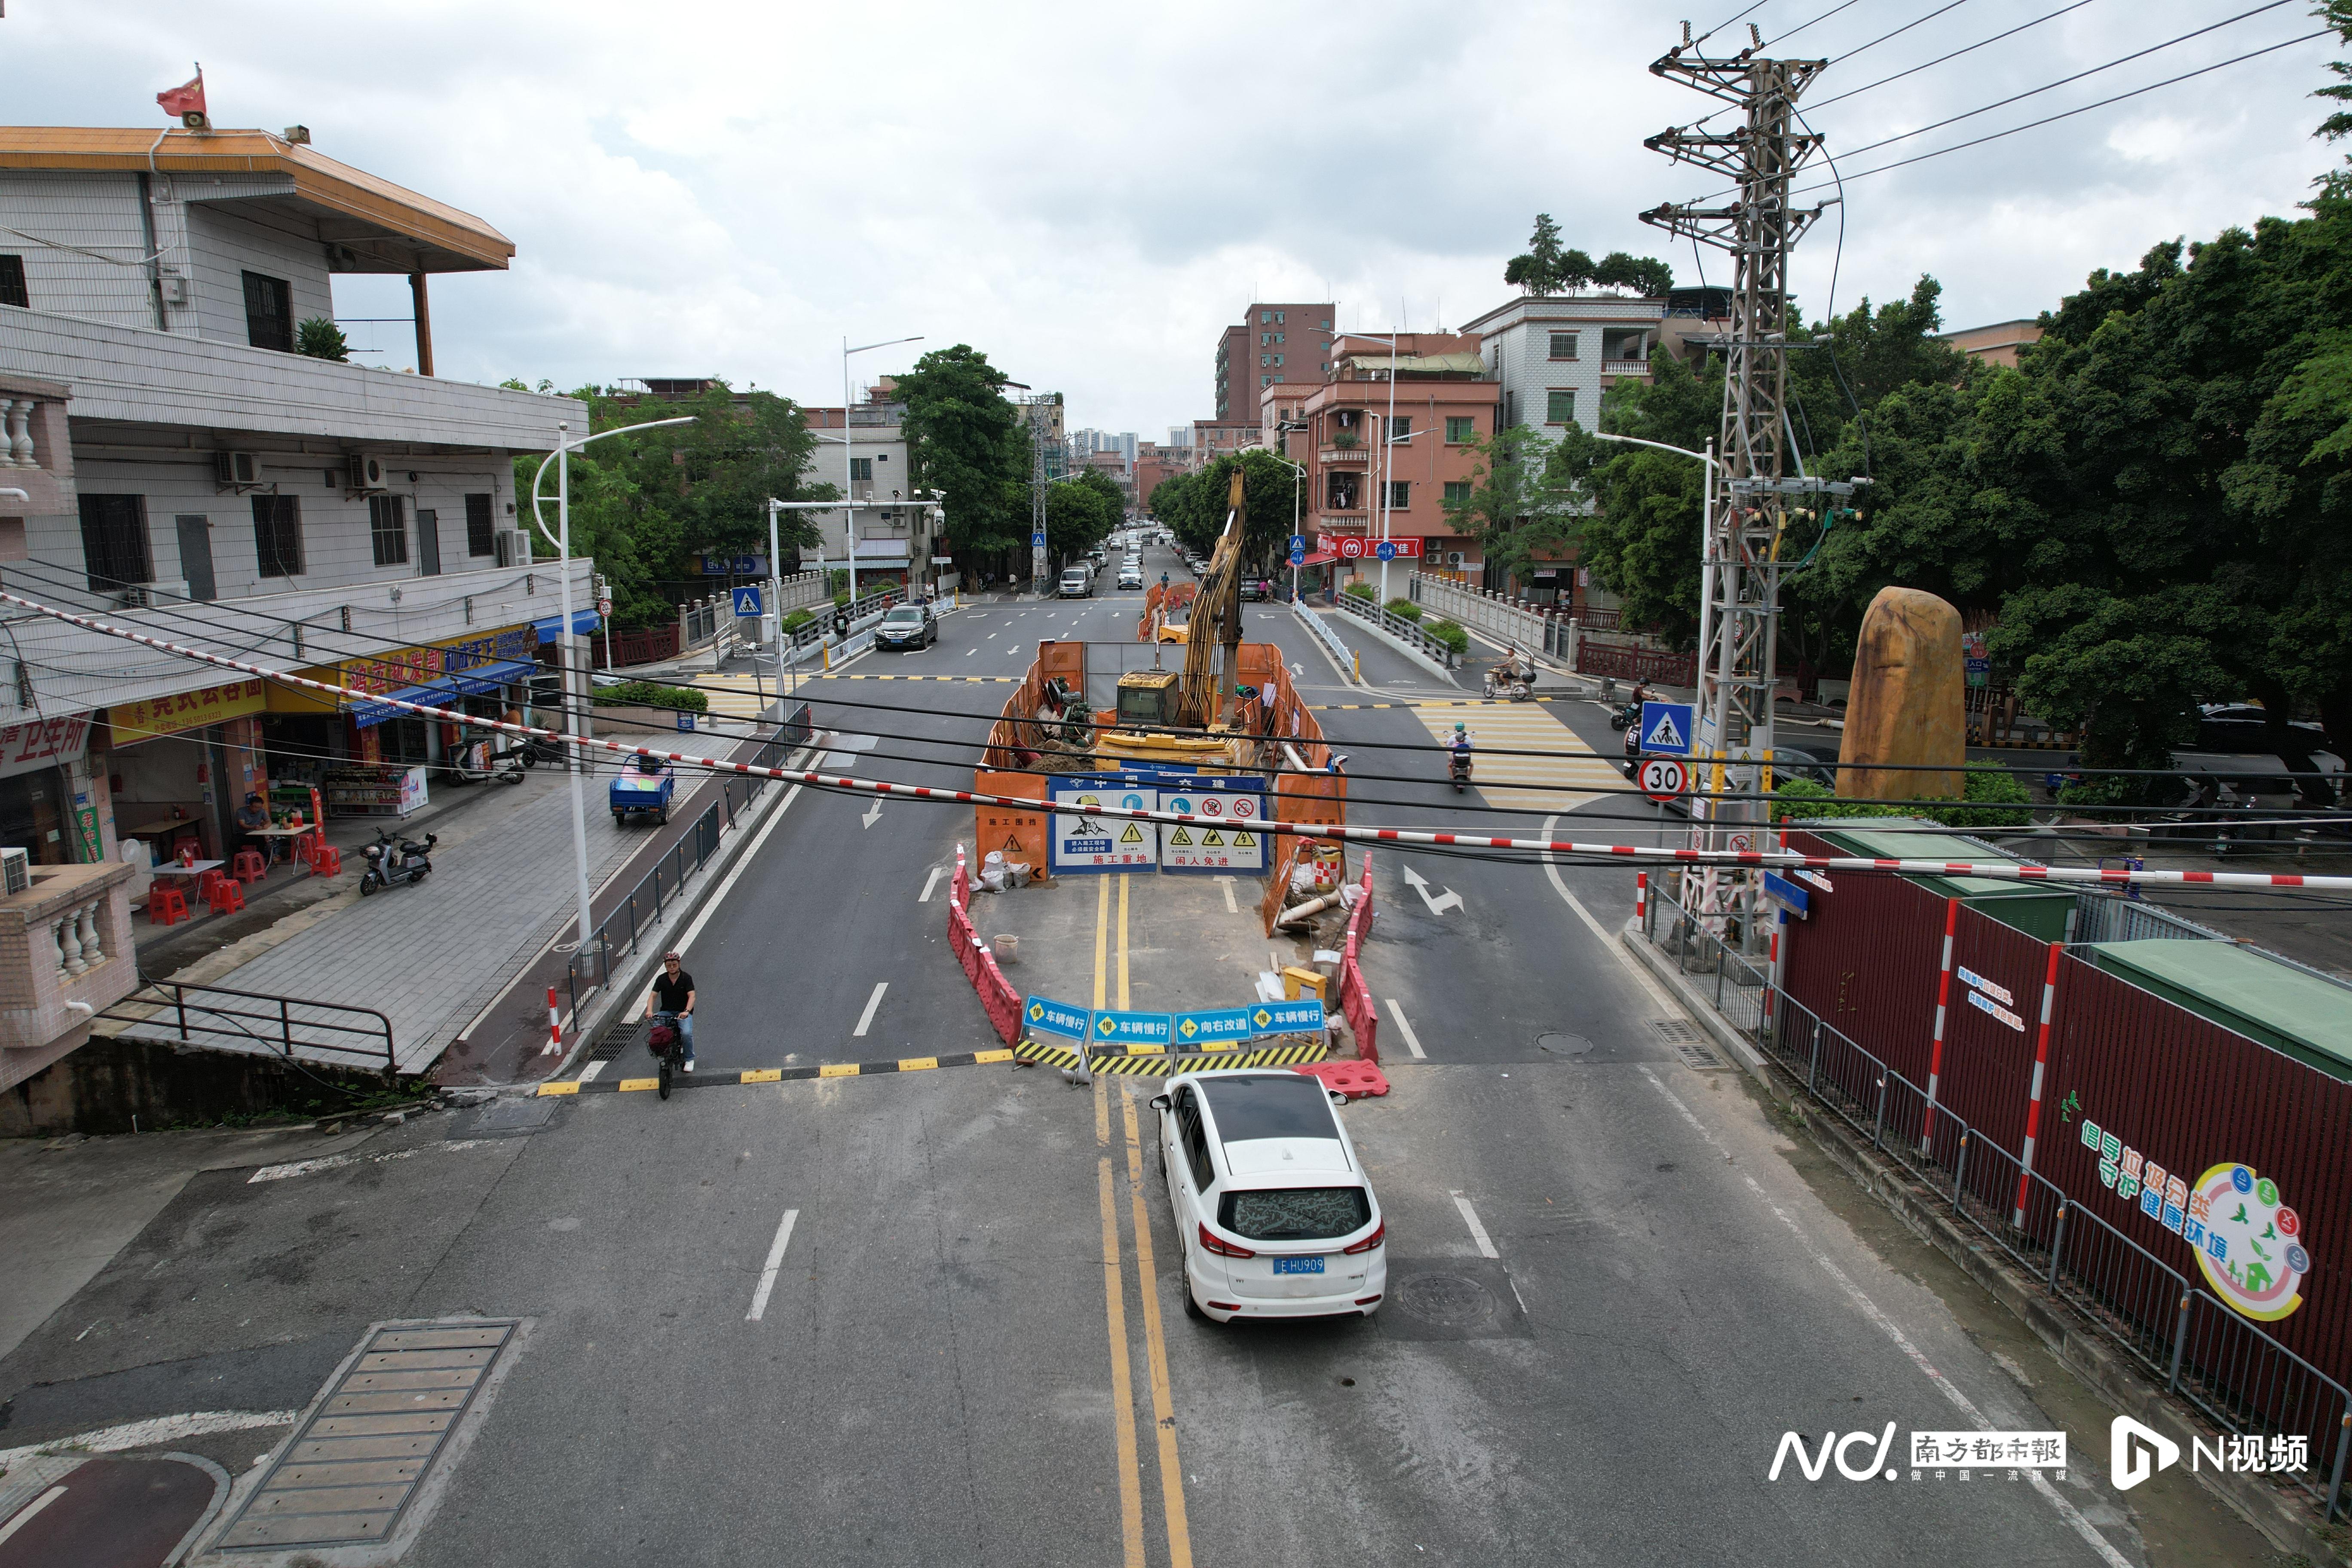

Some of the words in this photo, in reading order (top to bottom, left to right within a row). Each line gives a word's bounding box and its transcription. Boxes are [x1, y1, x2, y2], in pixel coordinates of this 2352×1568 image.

[14, 711, 89, 763] 卫生所
[1628, 732, 1638, 744] 91
[1650, 766, 1678, 790] 30
[1093, 854, 1147, 864] 施工重地
[1176, 856, 1229, 866] 闲人免进
[1046, 1010, 1085, 1031] 车辆慢行
[1274, 1010, 1320, 1024] 车辆慢行
[1120, 1021, 1168, 1036] 车辆慢行
[1201, 1018, 1247, 1033] 向右改道
[2082, 1120, 2210, 1222] 倡导垃圾分类
[2100, 1158, 2228, 1263] 守护健康环境
